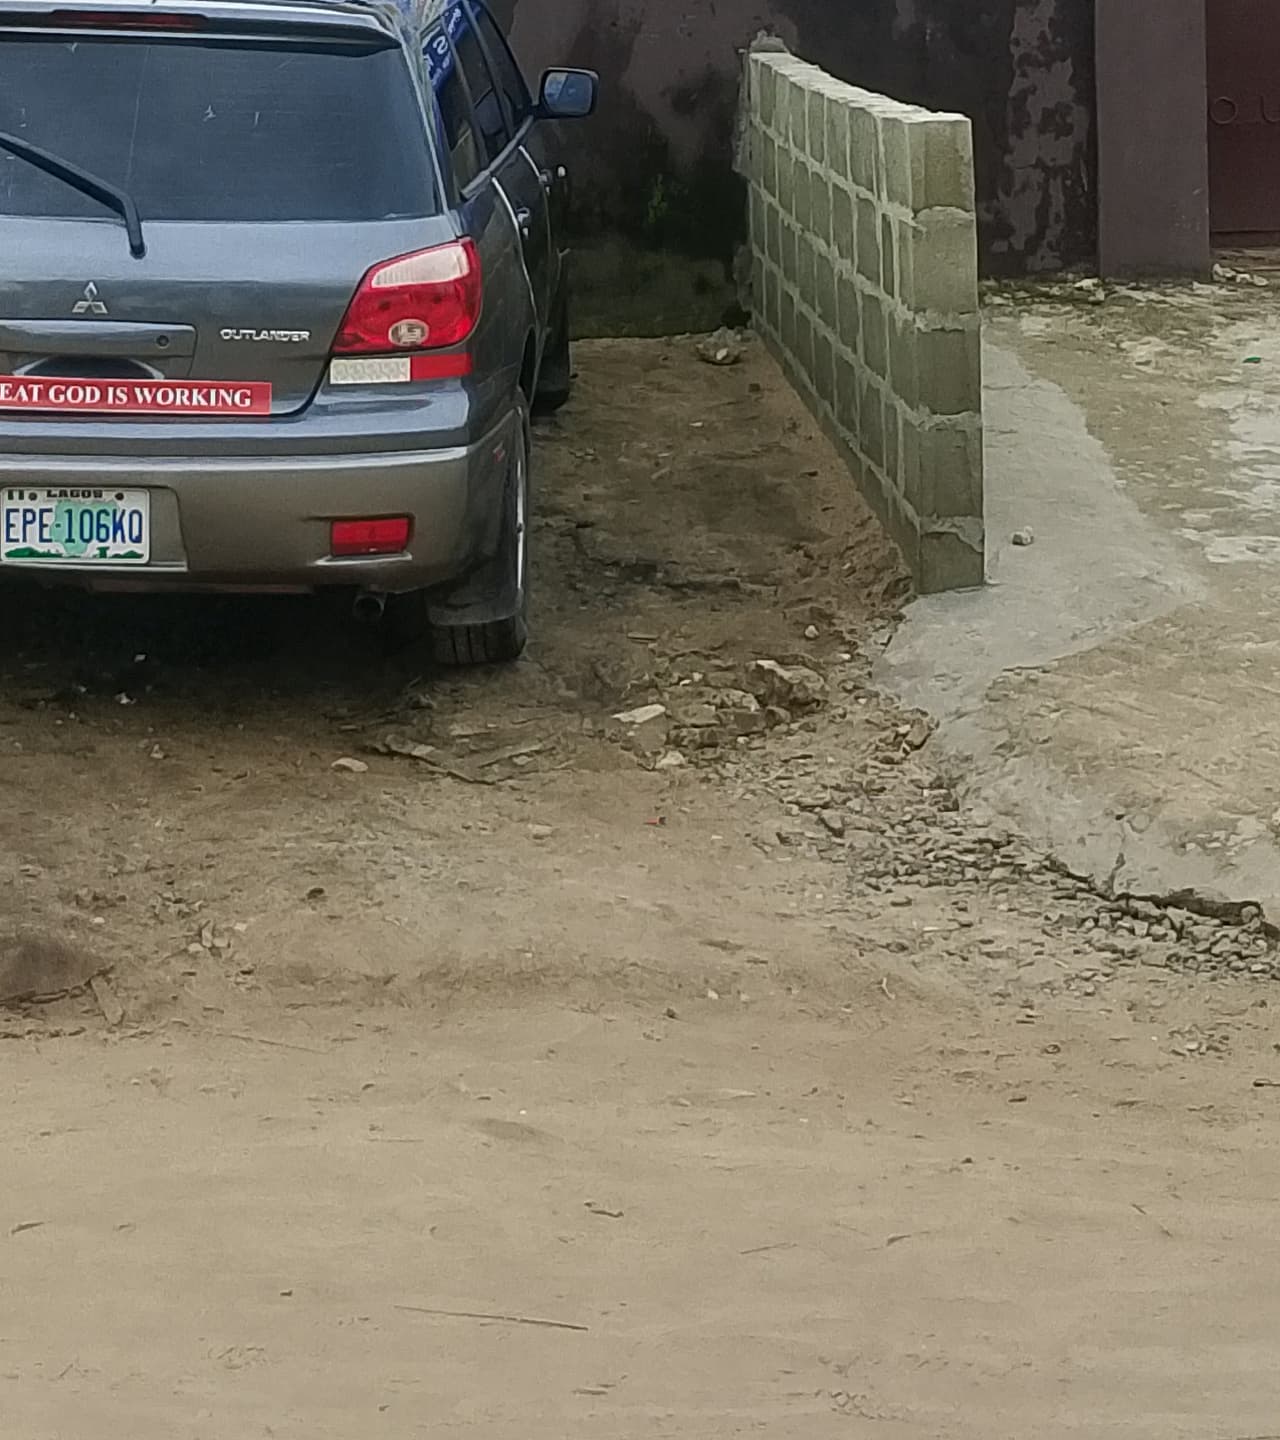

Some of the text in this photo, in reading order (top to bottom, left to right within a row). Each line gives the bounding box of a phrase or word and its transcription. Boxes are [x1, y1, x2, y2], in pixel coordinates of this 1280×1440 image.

[220, 329, 310, 341] OUTLANDER
[48, 385, 101, 405] GOD
[107, 386, 129, 406] IS
[133, 387, 252, 408] WORKING
[46, 489, 104, 499] LAGOS
